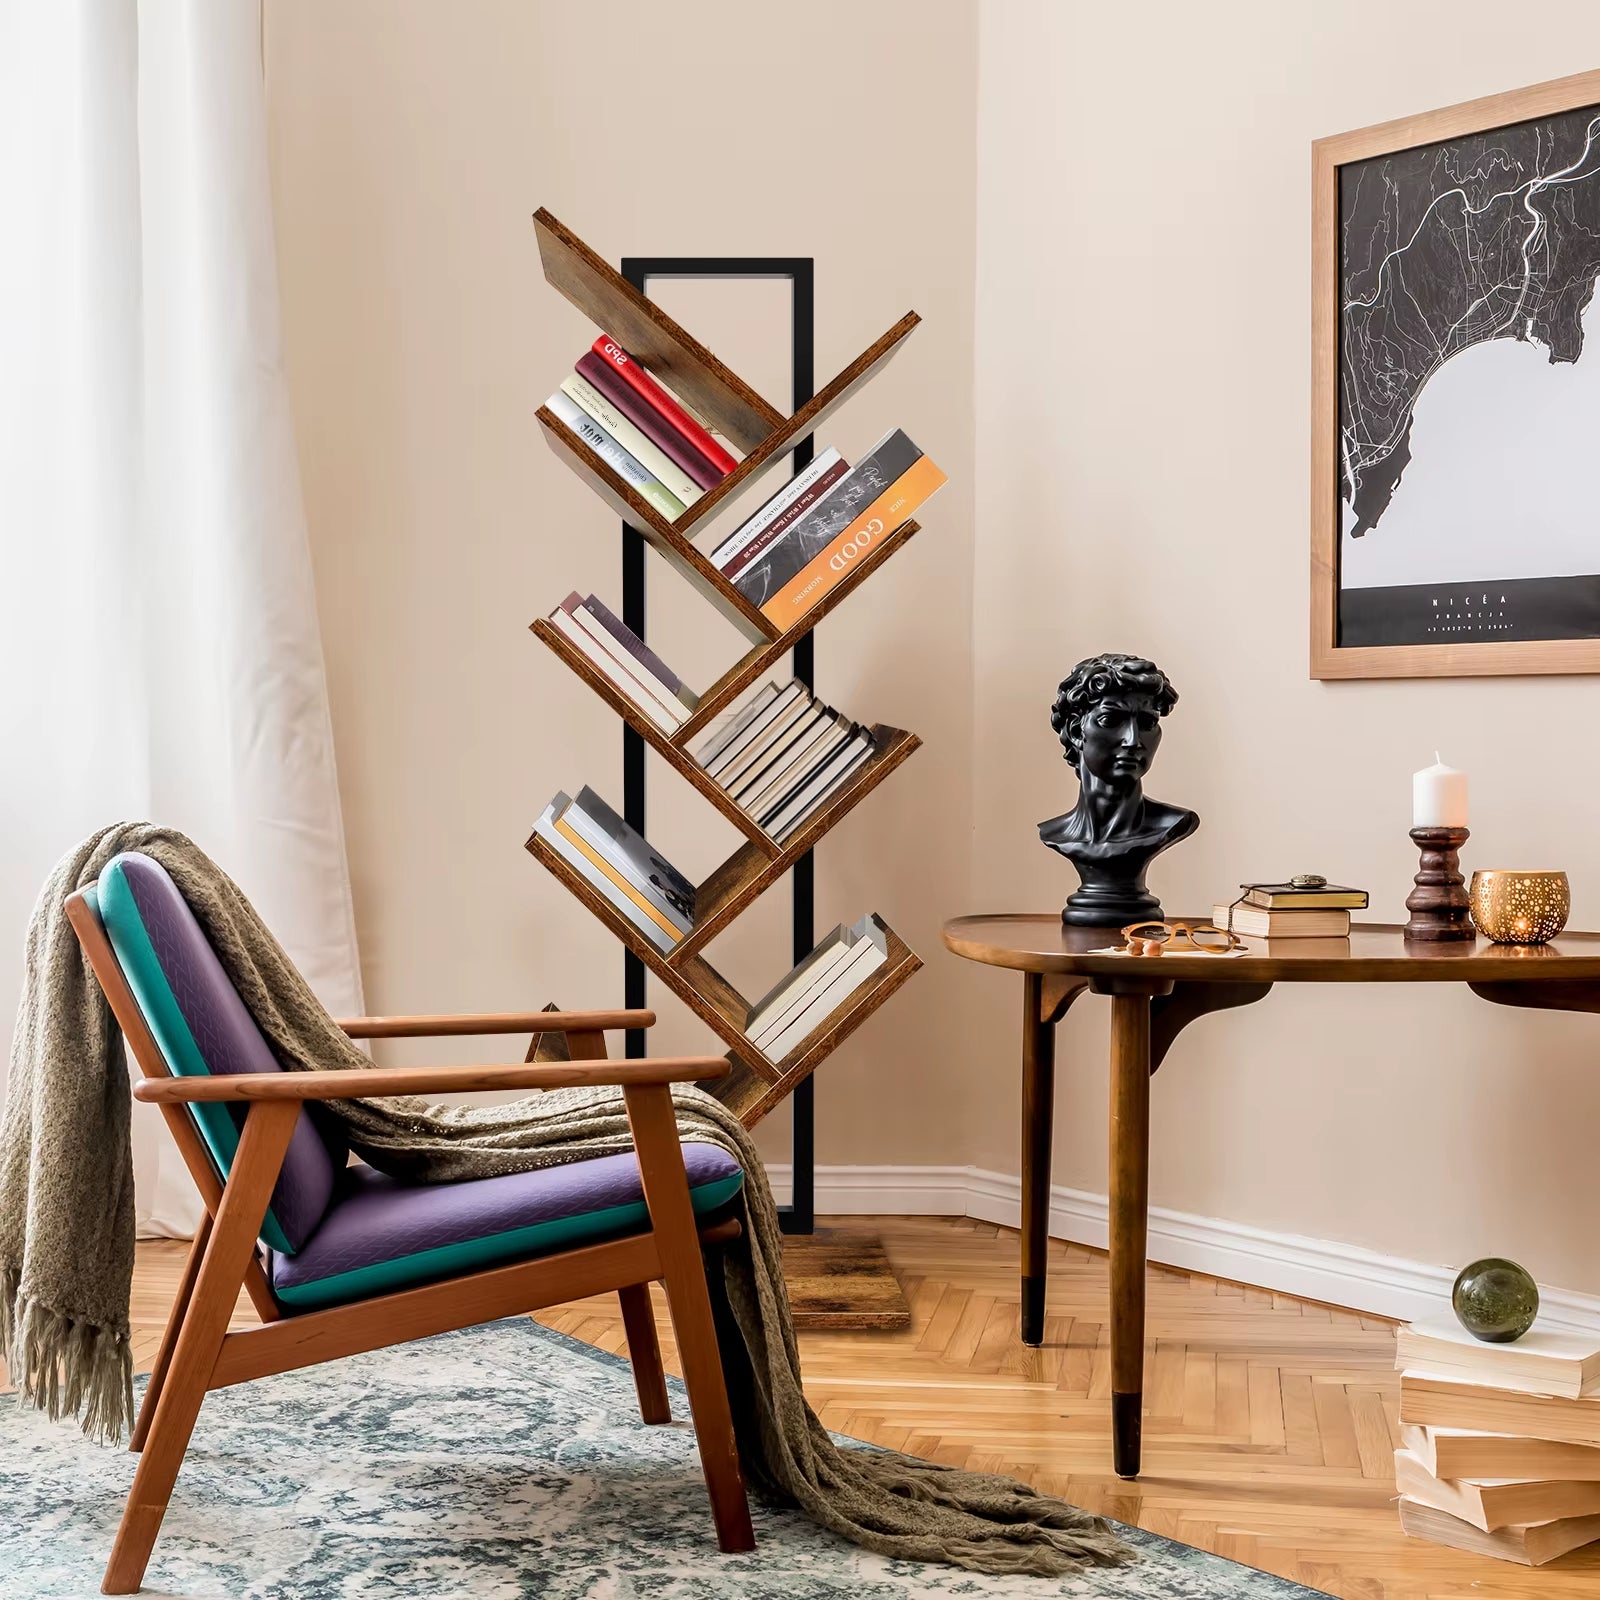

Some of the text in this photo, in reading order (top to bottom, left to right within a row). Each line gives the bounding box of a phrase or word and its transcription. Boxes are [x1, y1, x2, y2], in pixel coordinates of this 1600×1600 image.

[801, 493, 814, 505] What
[889, 498, 906, 513] NICE
[786, 506, 799, 518] Wish
[772, 519, 785, 531] Knew
[760, 530, 774, 542] When
[749, 541, 759, 551] Was
[830, 518, 884, 571] GOOD
[792, 576, 824, 605] MORNING
[1432, 594, 1506, 606] NICÉA
